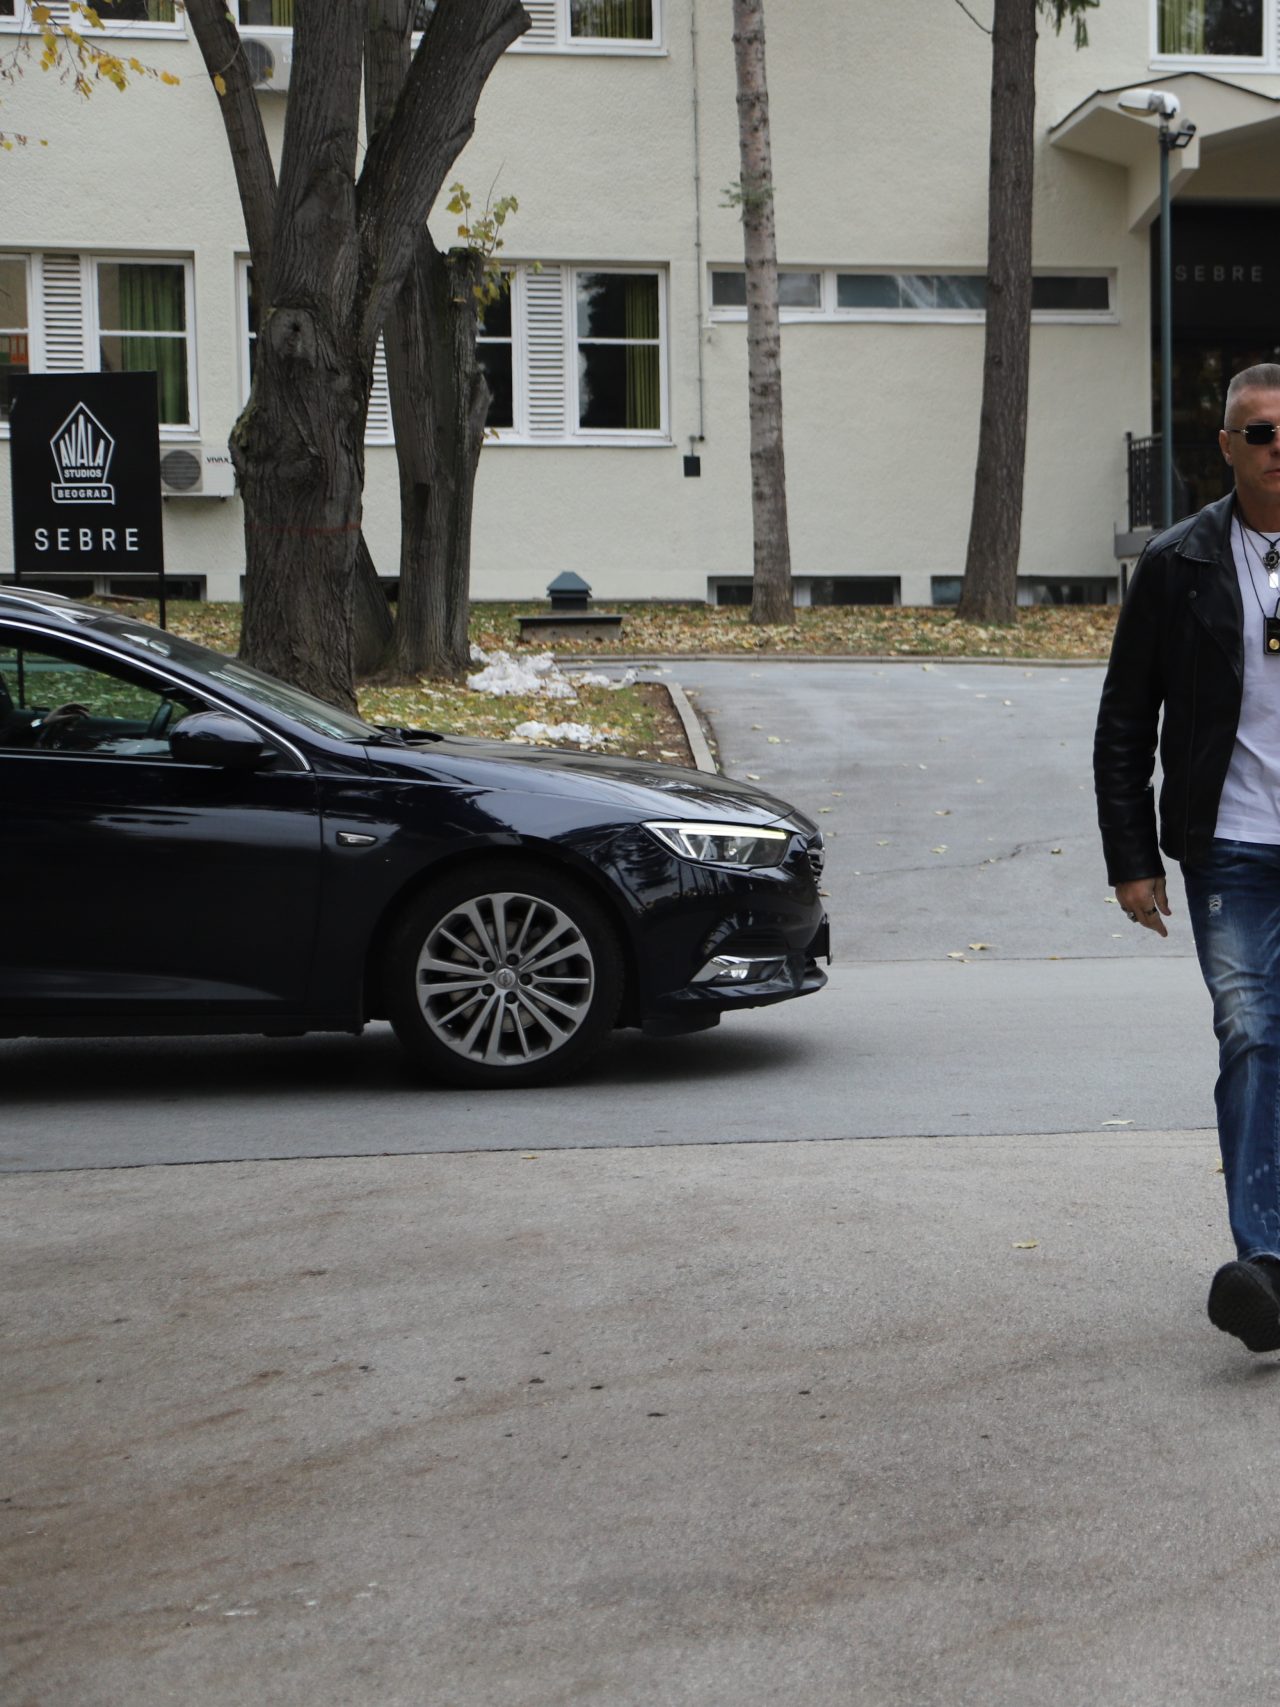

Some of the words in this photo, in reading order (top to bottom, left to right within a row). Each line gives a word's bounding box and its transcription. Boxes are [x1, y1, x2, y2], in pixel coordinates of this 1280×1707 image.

[1175, 265, 1263, 283] SEBRE
[59, 414, 105, 467] AVALA
[64, 469, 102, 478] STUDIOS
[58, 489, 108, 498] BEOGRAD
[34, 528, 139, 551] SEBRE
